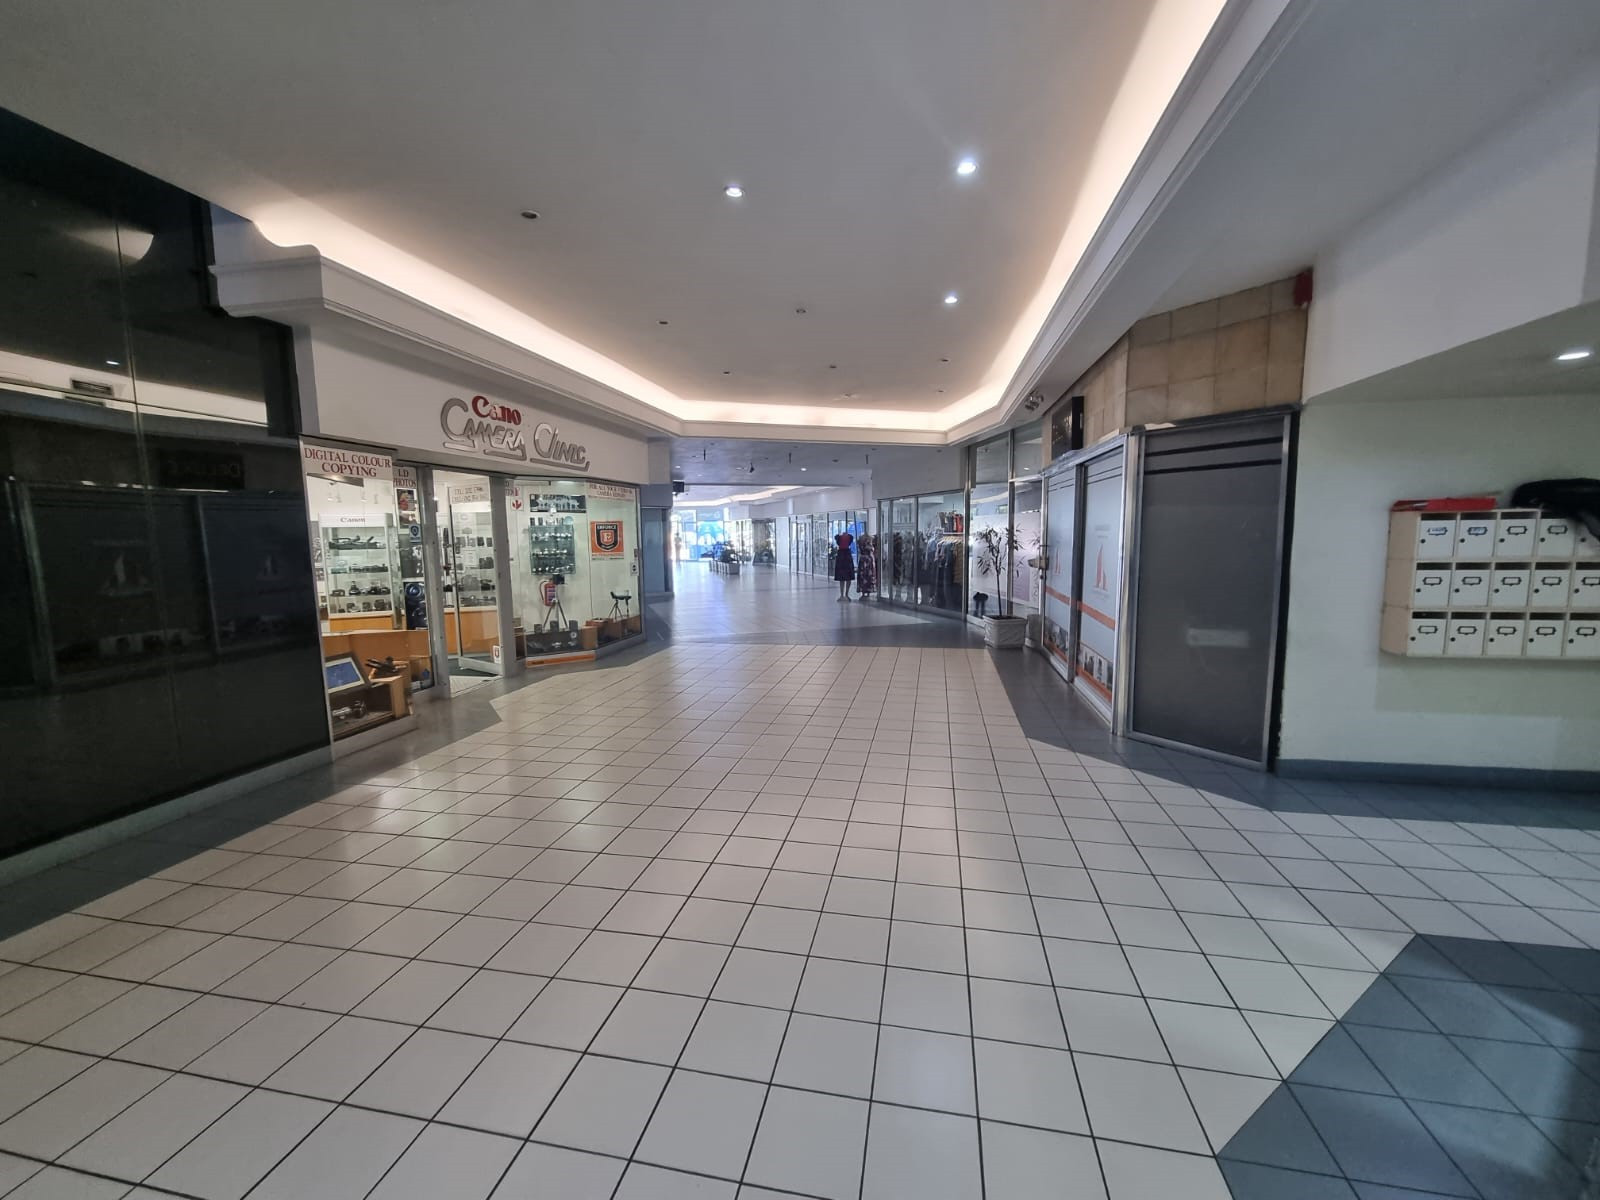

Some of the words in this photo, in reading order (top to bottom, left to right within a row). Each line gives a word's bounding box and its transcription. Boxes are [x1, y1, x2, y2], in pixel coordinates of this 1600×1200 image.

[440, 397, 527, 461] CAMERA
[304, 447, 349, 463] DIGITAL
[351, 454, 391, 468] COLOUR
[321, 462, 377, 478] COPYING
